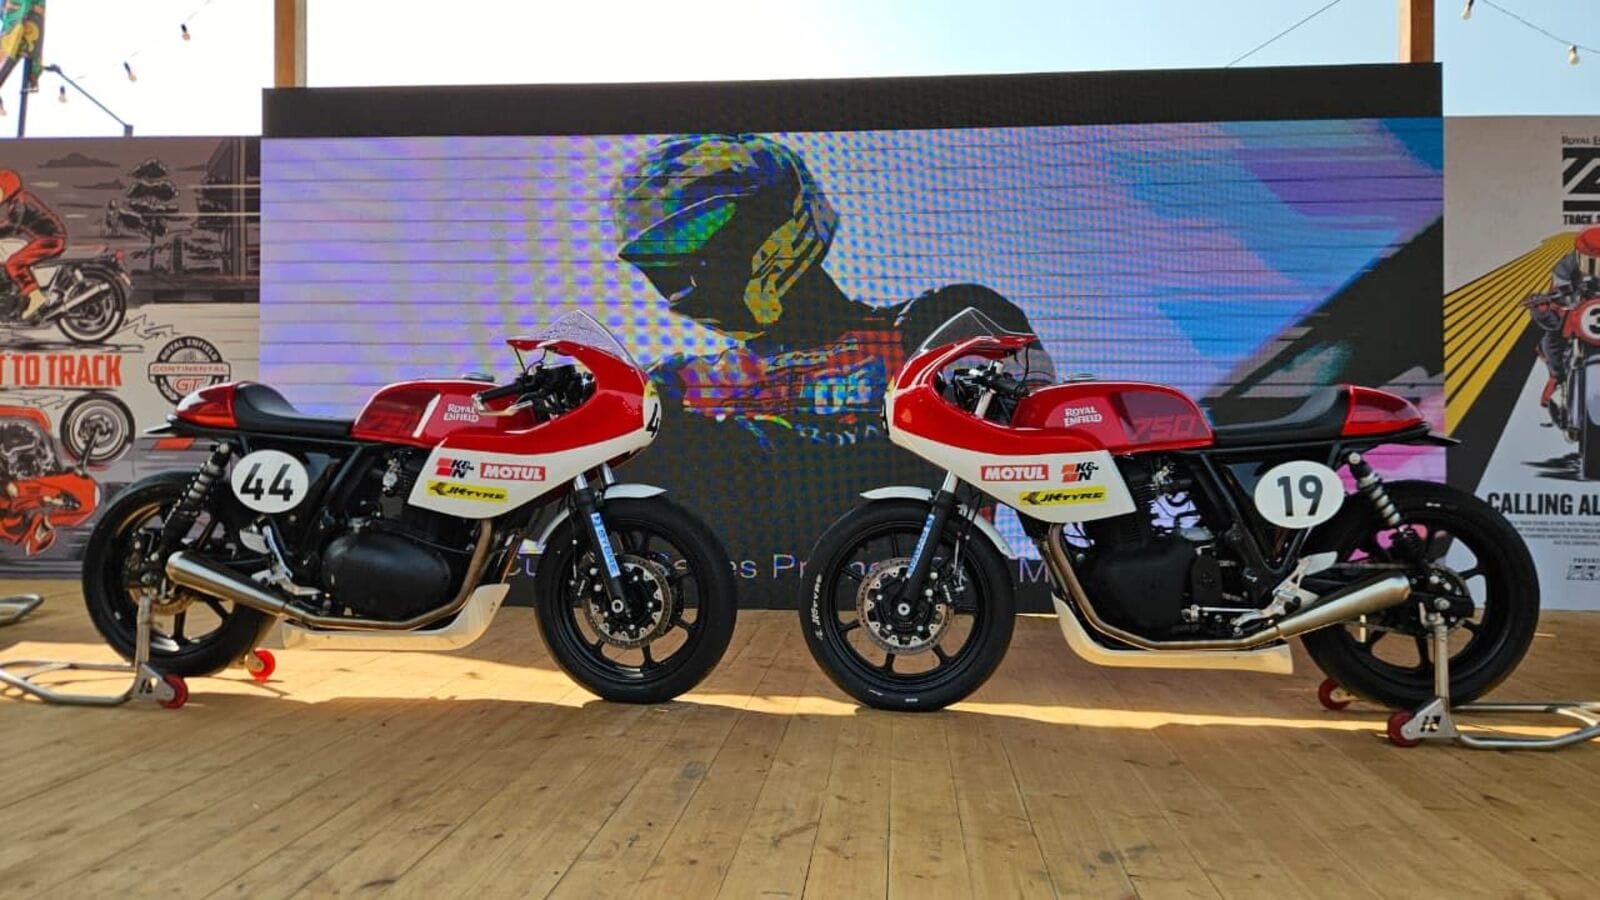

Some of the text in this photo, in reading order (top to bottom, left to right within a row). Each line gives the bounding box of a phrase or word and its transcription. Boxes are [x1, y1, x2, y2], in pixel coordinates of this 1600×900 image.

[1563, 214, 1592, 225] TRACK
[12, 354, 40, 386] TO
[46, 354, 122, 386] TRACK
[152, 364, 226, 373] CONTINENTAL
[175, 377, 207, 392] GT
[447, 403, 476, 414] ROYAL
[1064, 406, 1097, 417] ROYAL
[443, 412, 479, 423] ENFIELD
[645, 402, 660, 438] 4
[1064, 413, 1102, 427] ENFIELD
[483, 464, 542, 480] MOTUL
[984, 466, 1045, 480] MOTUL
[240, 462, 294, 502] 44
[1277, 474, 1323, 517] 19
[1487, 492, 1573, 515] CALLING
